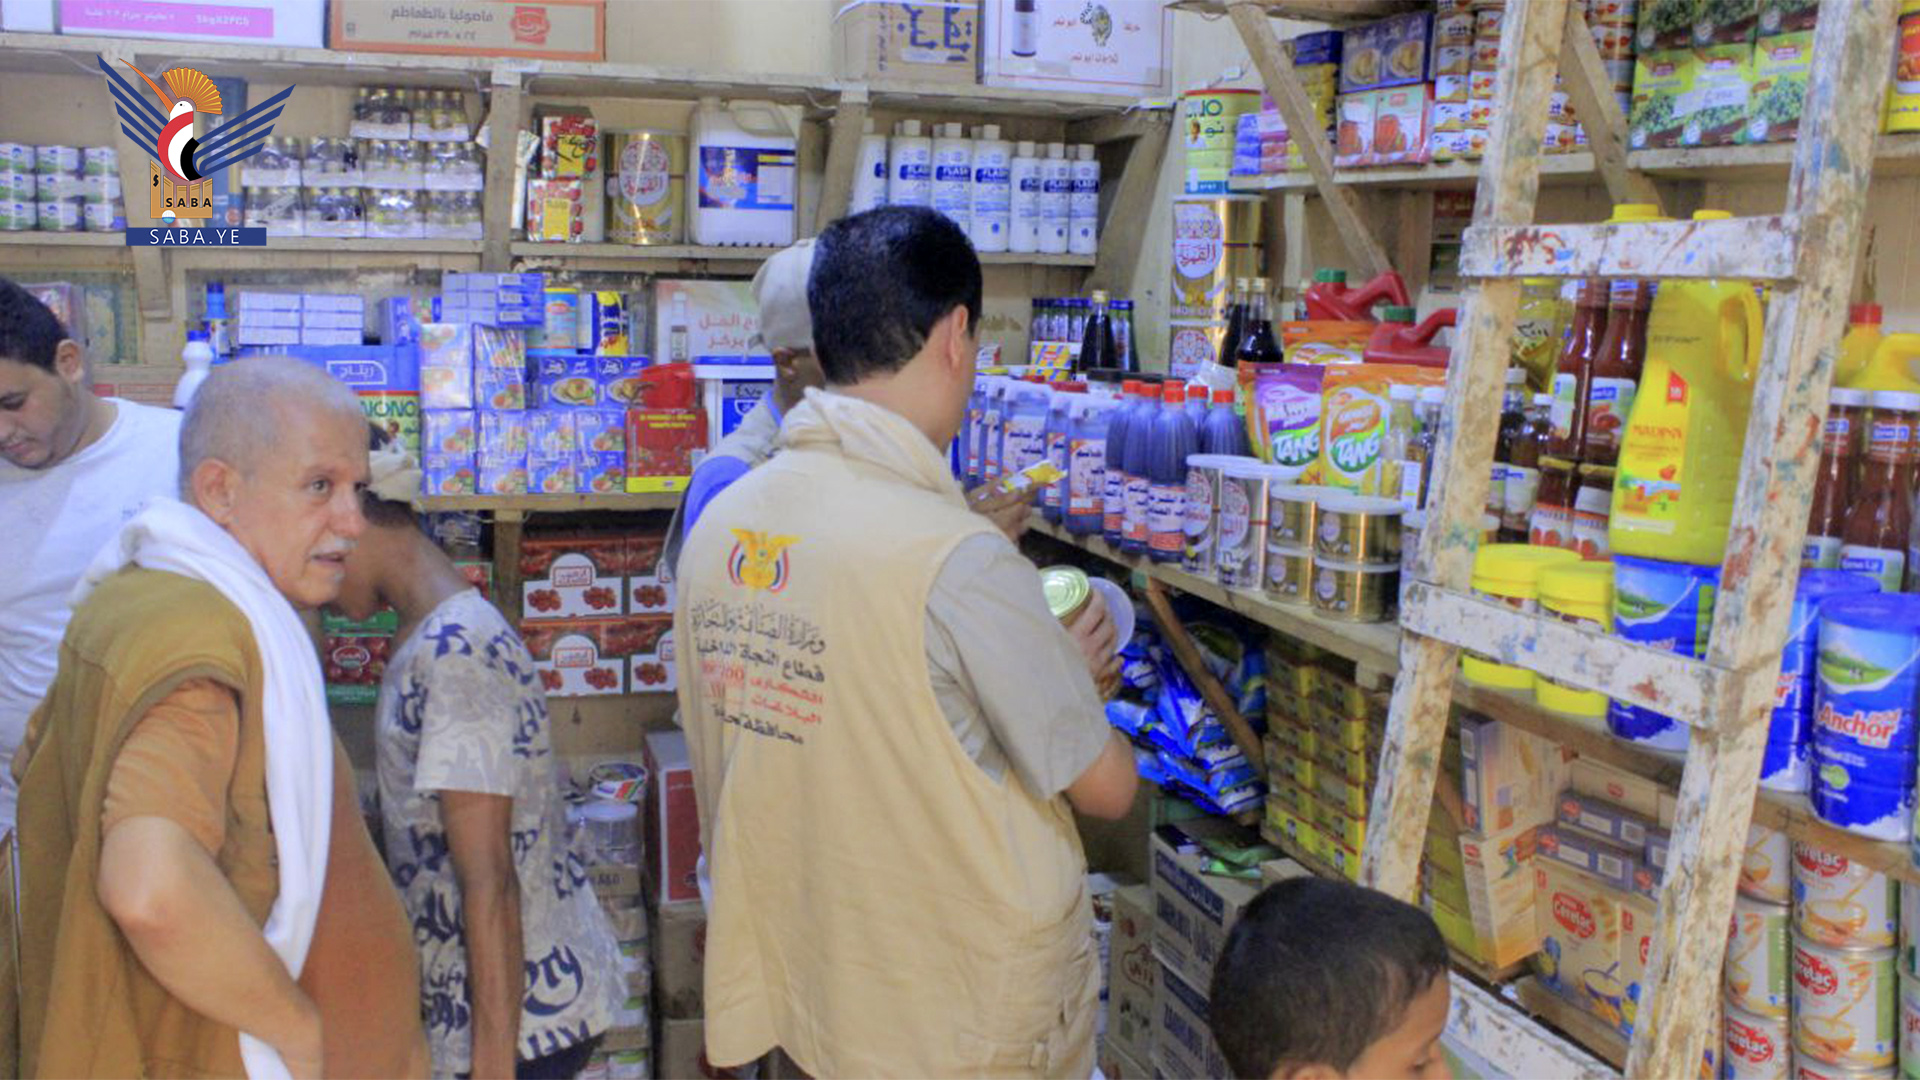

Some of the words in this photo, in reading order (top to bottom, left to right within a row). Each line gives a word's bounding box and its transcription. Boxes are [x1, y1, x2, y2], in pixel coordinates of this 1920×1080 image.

[1273, 429, 1320, 462] TANG
[1333, 432, 1381, 469] TANG
[1818, 700, 1896, 741] Anchor
